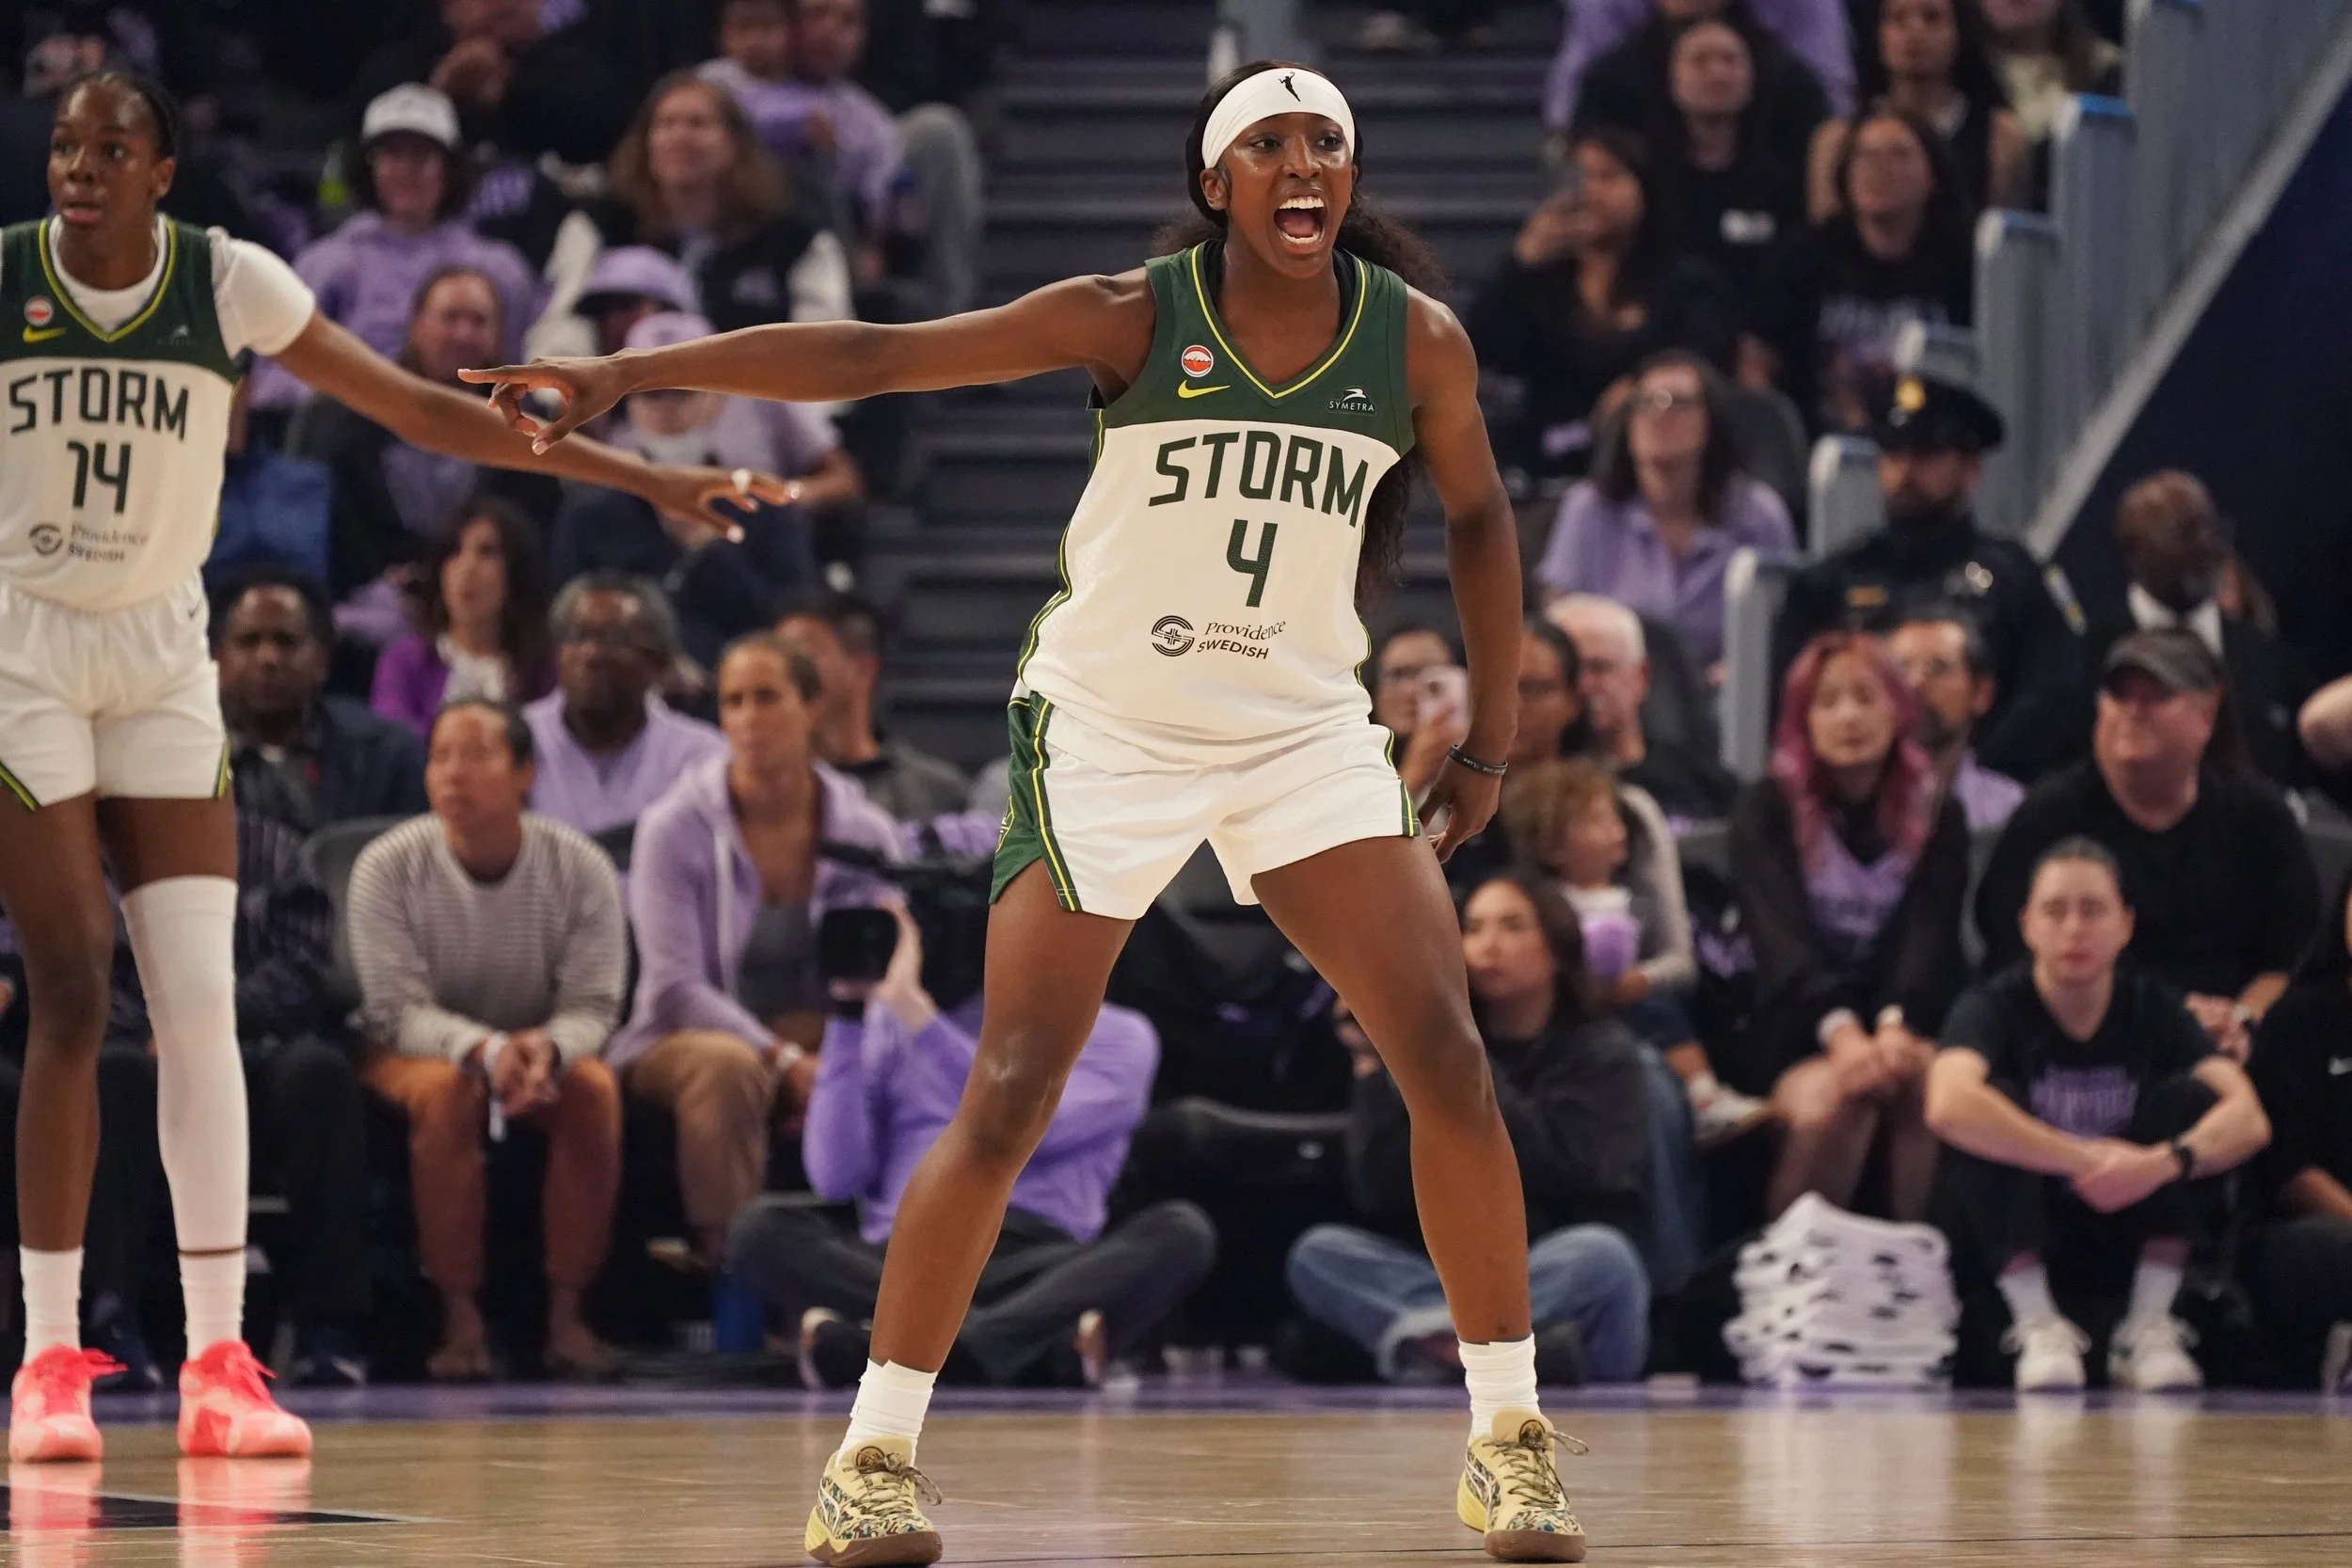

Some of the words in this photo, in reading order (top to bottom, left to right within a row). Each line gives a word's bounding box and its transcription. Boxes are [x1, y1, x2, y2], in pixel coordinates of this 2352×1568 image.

[8, 367, 189, 442] STORM
[1328, 400, 1375, 412] SYMETRA
[67, 441, 131, 514] 14
[1148, 430, 1369, 529] STORM
[1226, 518, 1279, 608] 4
[1197, 640, 1269, 659] SWEDISH
[1204, 621, 1286, 641] Providence
